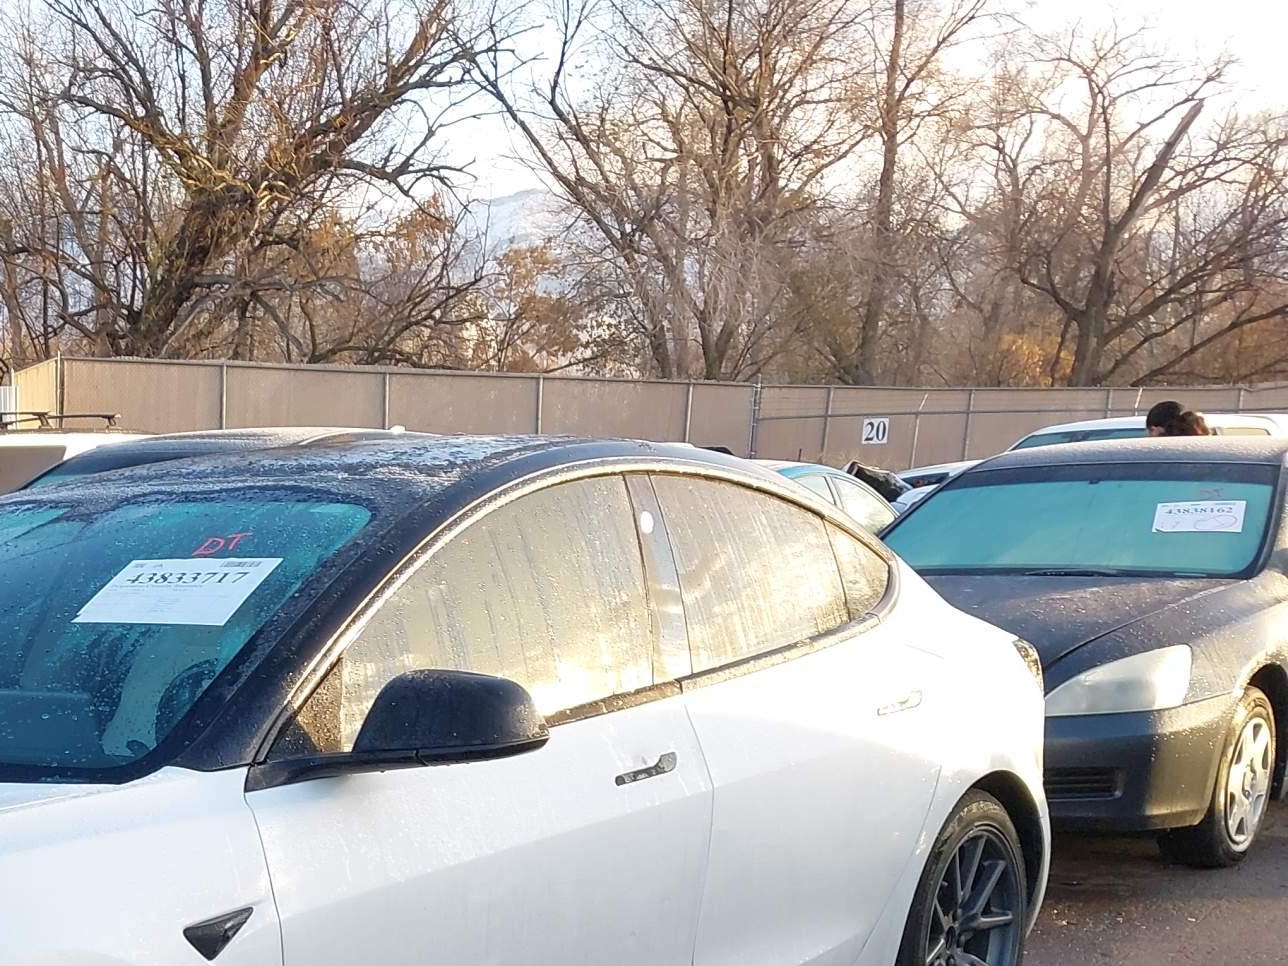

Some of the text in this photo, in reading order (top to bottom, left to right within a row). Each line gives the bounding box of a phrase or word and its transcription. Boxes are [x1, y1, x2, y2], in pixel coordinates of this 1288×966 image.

[863, 420, 887, 442] 20
[192, 532, 254, 556] DT
[125, 571, 250, 585] 43833717
